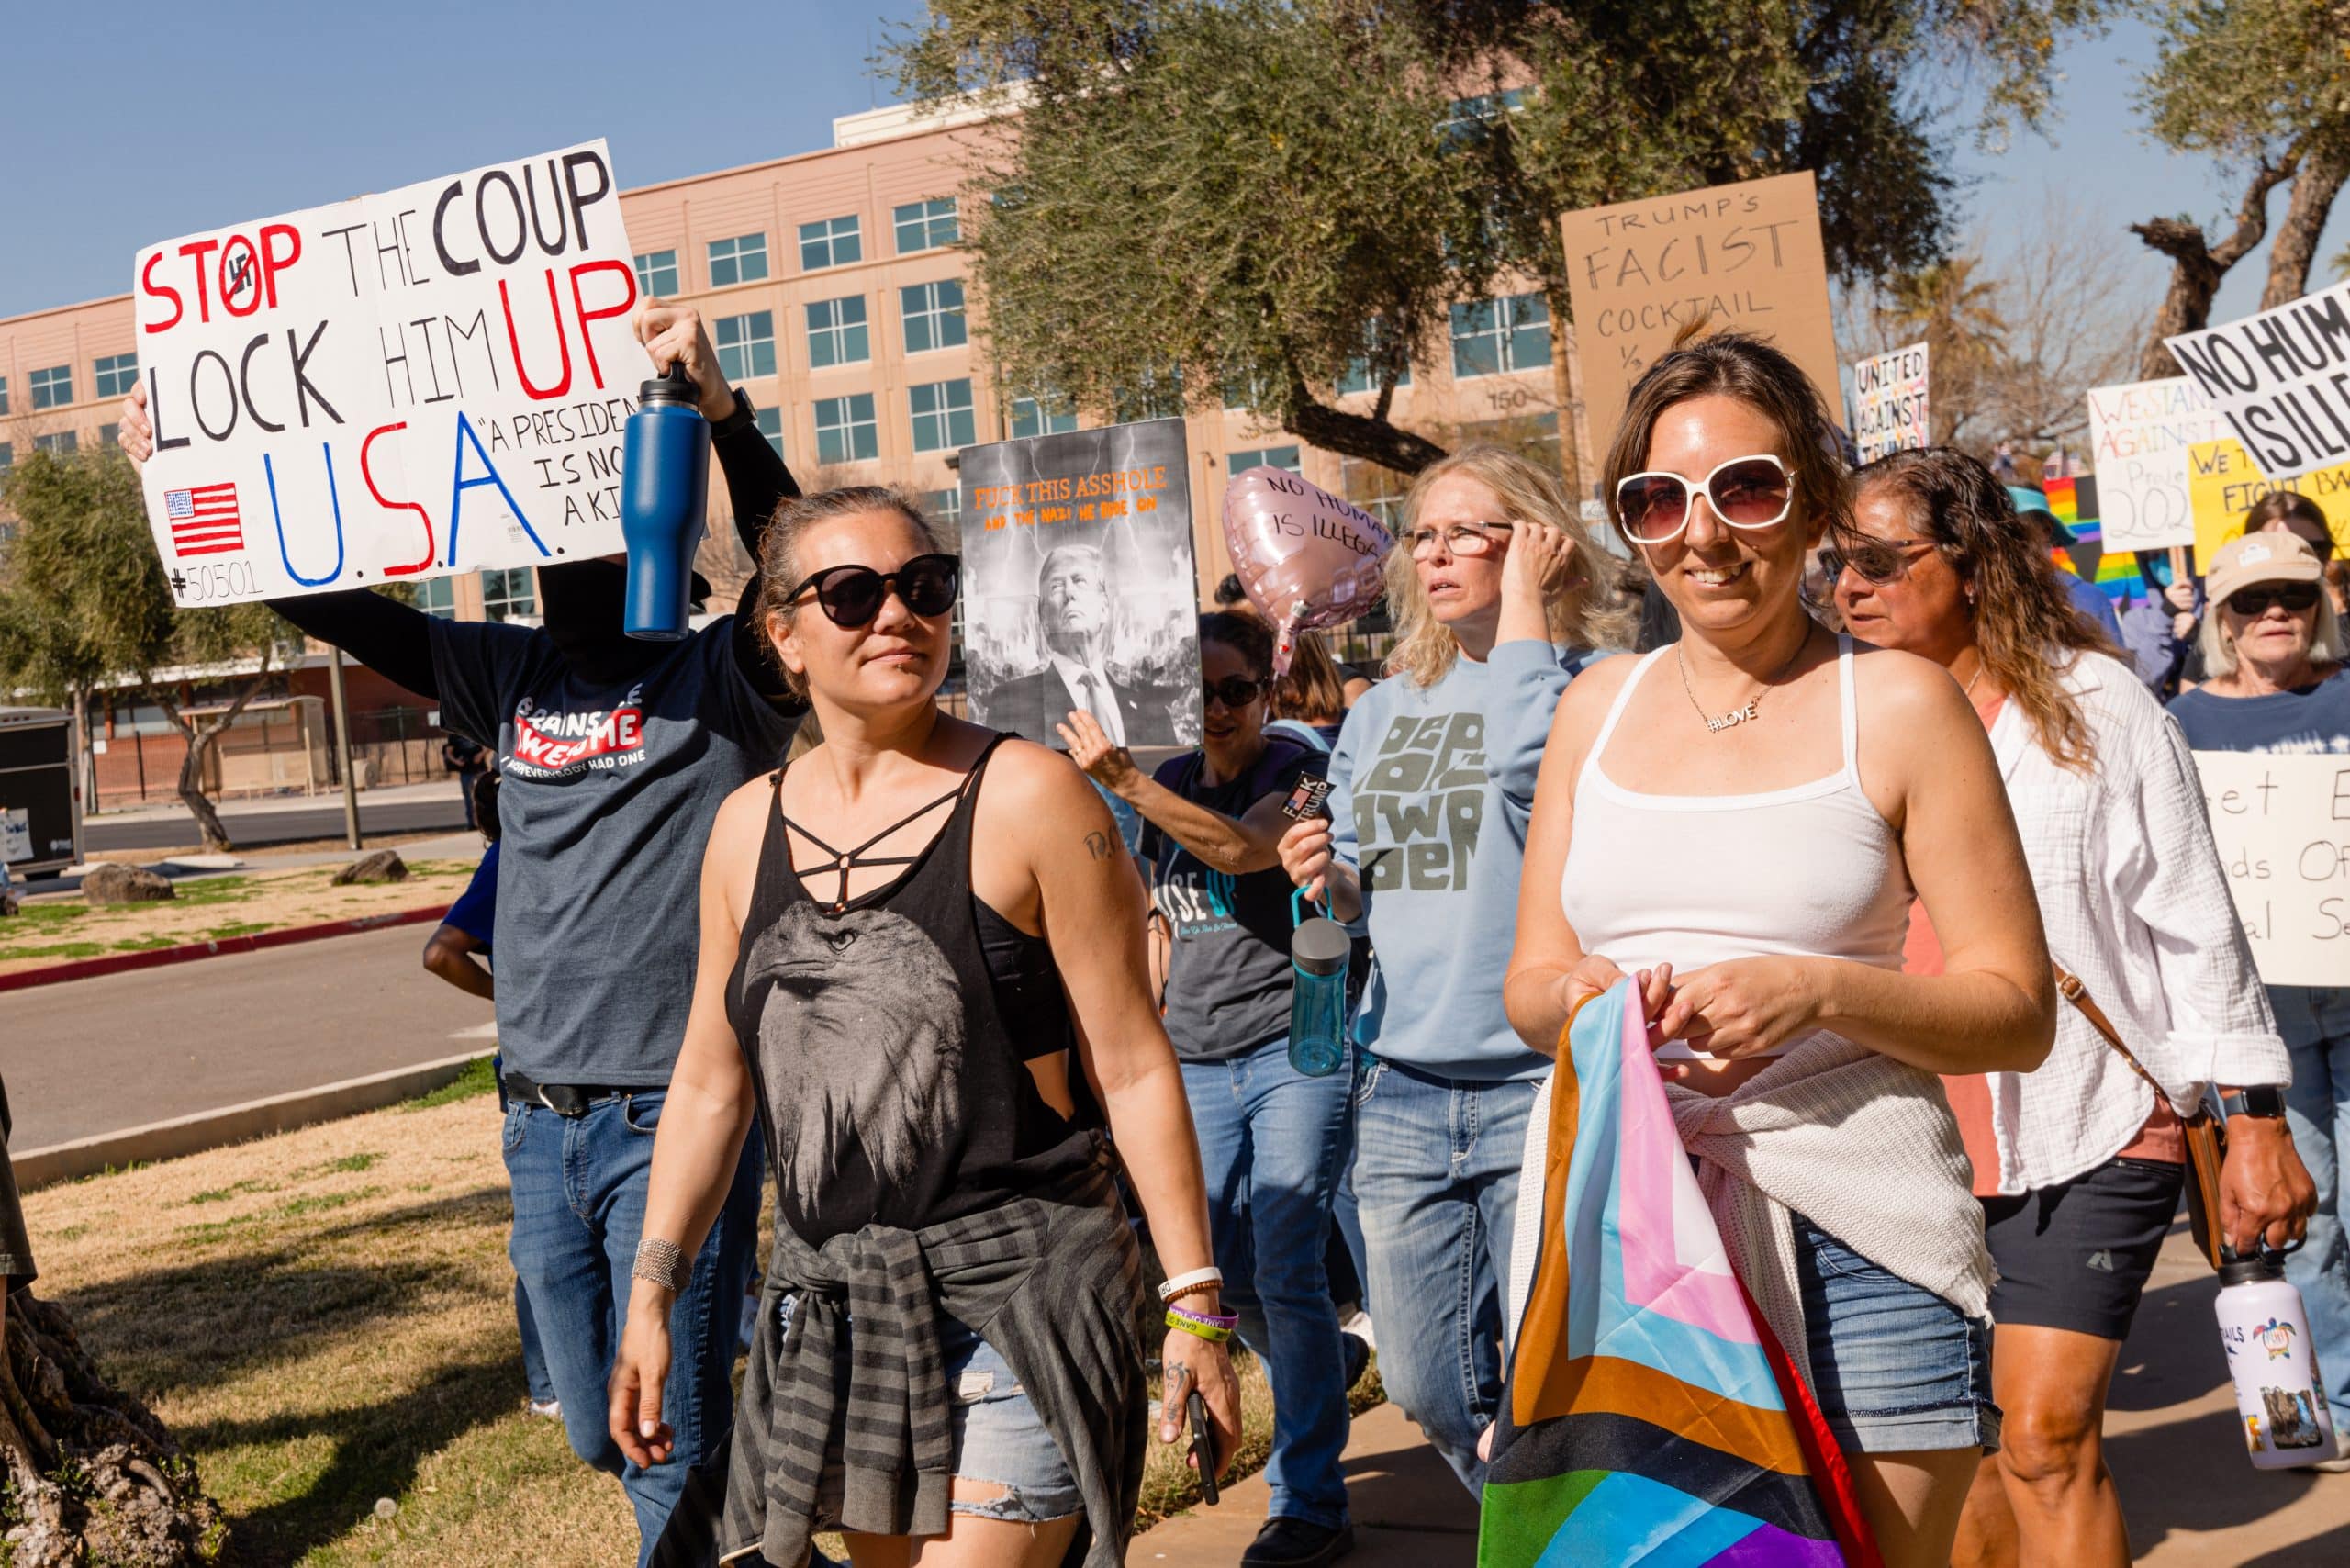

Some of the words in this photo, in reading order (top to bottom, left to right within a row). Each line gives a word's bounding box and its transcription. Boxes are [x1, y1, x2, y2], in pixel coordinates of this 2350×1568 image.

[1595, 192, 1760, 238] TRUMP'S
[142, 223, 302, 334] STOP
[322, 209, 430, 297] THE
[433, 151, 610, 276] COUP
[1583, 220, 1800, 290] FACIST
[1597, 291, 1775, 337] COCKTAIL
[150, 320, 345, 452] LOCK
[379, 308, 499, 408] HIM
[498, 260, 637, 400] UP
[2174, 333, 2259, 398] NO
[2241, 289, 2350, 382] HUM
[1858, 352, 1923, 394] UNITED
[1488, 389, 1528, 410] 150
[1861, 392, 1925, 438] AGAINST
[2143, 384, 2215, 420] STAN
[513, 395, 642, 449] PRESIDEN
[2096, 420, 2227, 463] AGAINST
[2225, 405, 2303, 473] IS
[2271, 372, 2350, 459] ILL
[534, 454, 581, 488] IS
[588, 446, 624, 479] NO
[2191, 444, 2230, 475] WE
[974, 484, 1025, 510] FUCK
[1026, 477, 1071, 504] THIS
[1074, 465, 1168, 498] ASSHOLE
[1267, 476, 1304, 496] NO
[2314, 470, 2350, 496] BA
[565, 495, 585, 526] A
[588, 486, 621, 521] KI
[984, 514, 1007, 532] AND
[1013, 509, 1036, 527] THE
[1040, 506, 1072, 524] NAZI
[1136, 494, 1158, 513] ON
[2105, 484, 2195, 539] 202
[1273, 513, 1304, 537] IS
[1313, 513, 1381, 560] ILLEGA
[170, 559, 264, 601] #50501
[1707, 704, 1759, 733] #LOVE
[588, 757, 615, 771] HAD
[618, 749, 647, 767] ONE
[1294, 780, 1330, 823] TRUMP
[2205, 771, 2279, 815] et
[2333, 768, 2350, 821] E
[2222, 846, 2271, 880] ds
[2243, 900, 2271, 940] al
